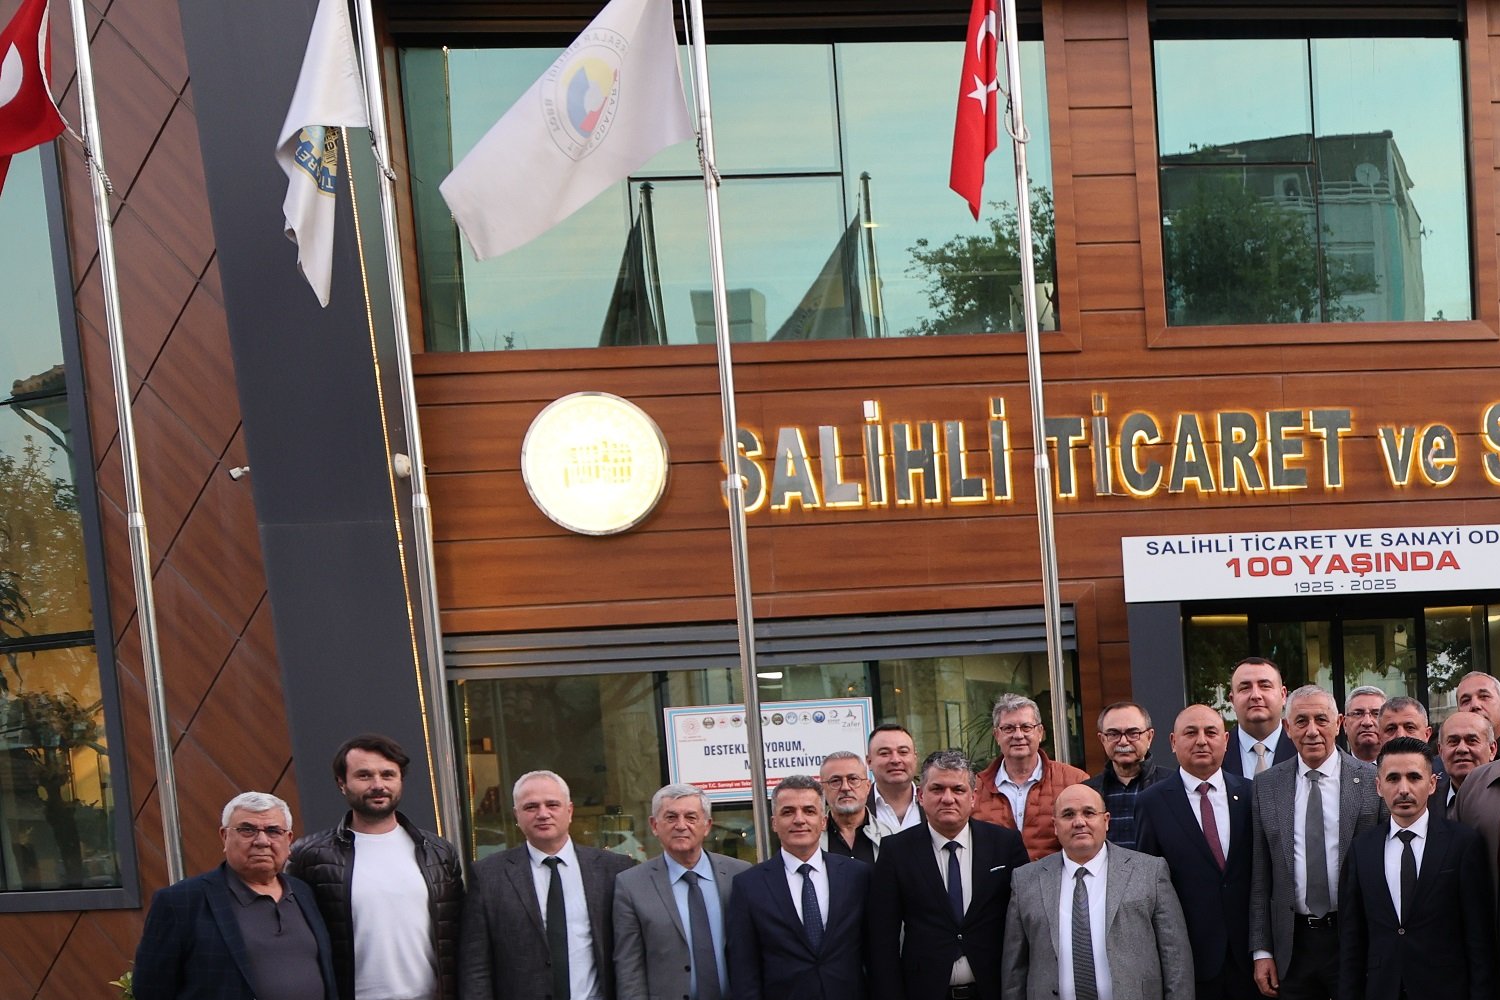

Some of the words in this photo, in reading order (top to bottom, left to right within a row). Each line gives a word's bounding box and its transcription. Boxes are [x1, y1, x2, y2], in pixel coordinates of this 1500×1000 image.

[721, 397, 1012, 512] SALİHLİ
[1045, 392, 1352, 499] TİCARET
[1379, 424, 1457, 486] ve
[1146, 536, 1233, 555] SALİHLİ
[1241, 534, 1337, 551] TİCARET
[1344, 533, 1373, 548] VE
[1380, 528, 1461, 547] SANAYİ
[1225, 556, 1293, 578] 100
[1300, 550, 1461, 577] YAŞINDA
[1294, 581, 1334, 593] 1925
[1350, 579, 1397, 591] 2025
